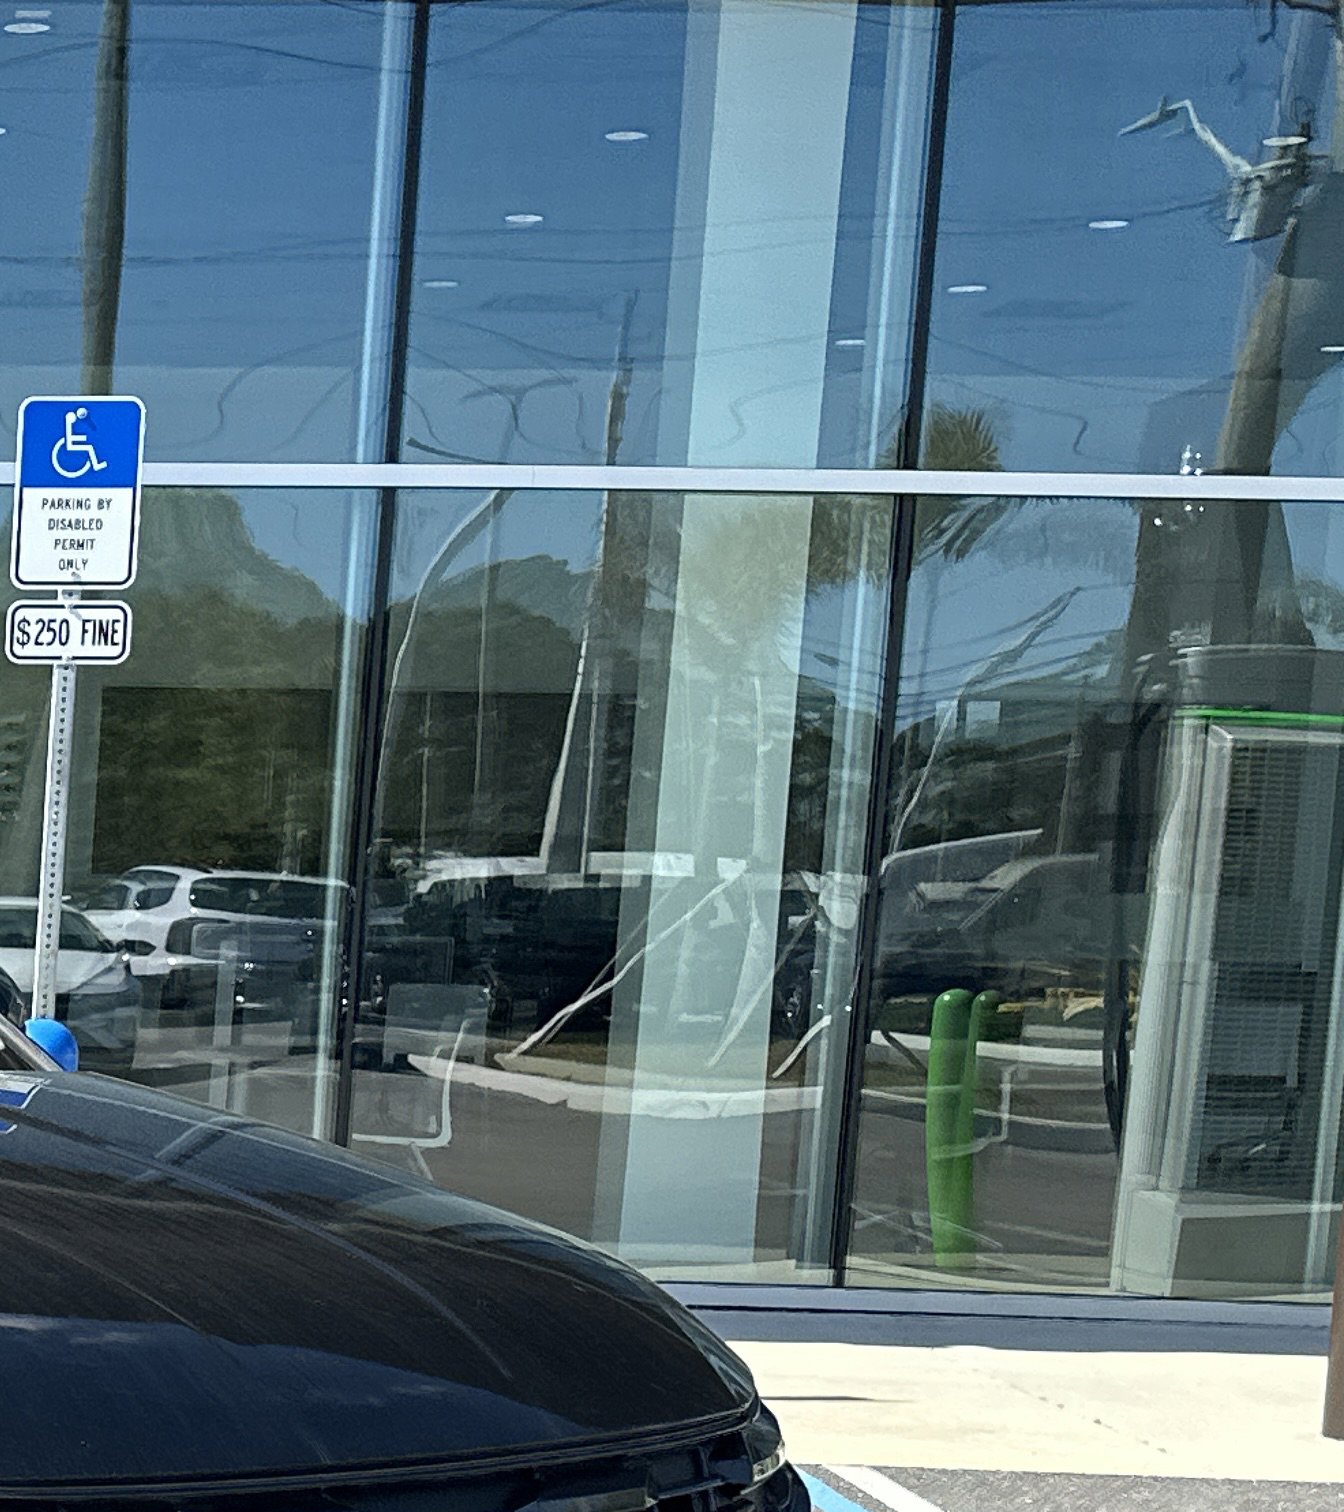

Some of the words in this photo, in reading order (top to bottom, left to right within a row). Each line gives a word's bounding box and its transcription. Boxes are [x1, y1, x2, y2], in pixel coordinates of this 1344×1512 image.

[41, 498, 91, 510] PARKING
[97, 498, 113, 510] BY
[47, 518, 104, 531] DISABLED
[53, 538, 96, 551] PERMIT
[58, 559, 89, 571] ONLY
[16, 616, 70, 649] $250
[81, 619, 121, 646] FINE
